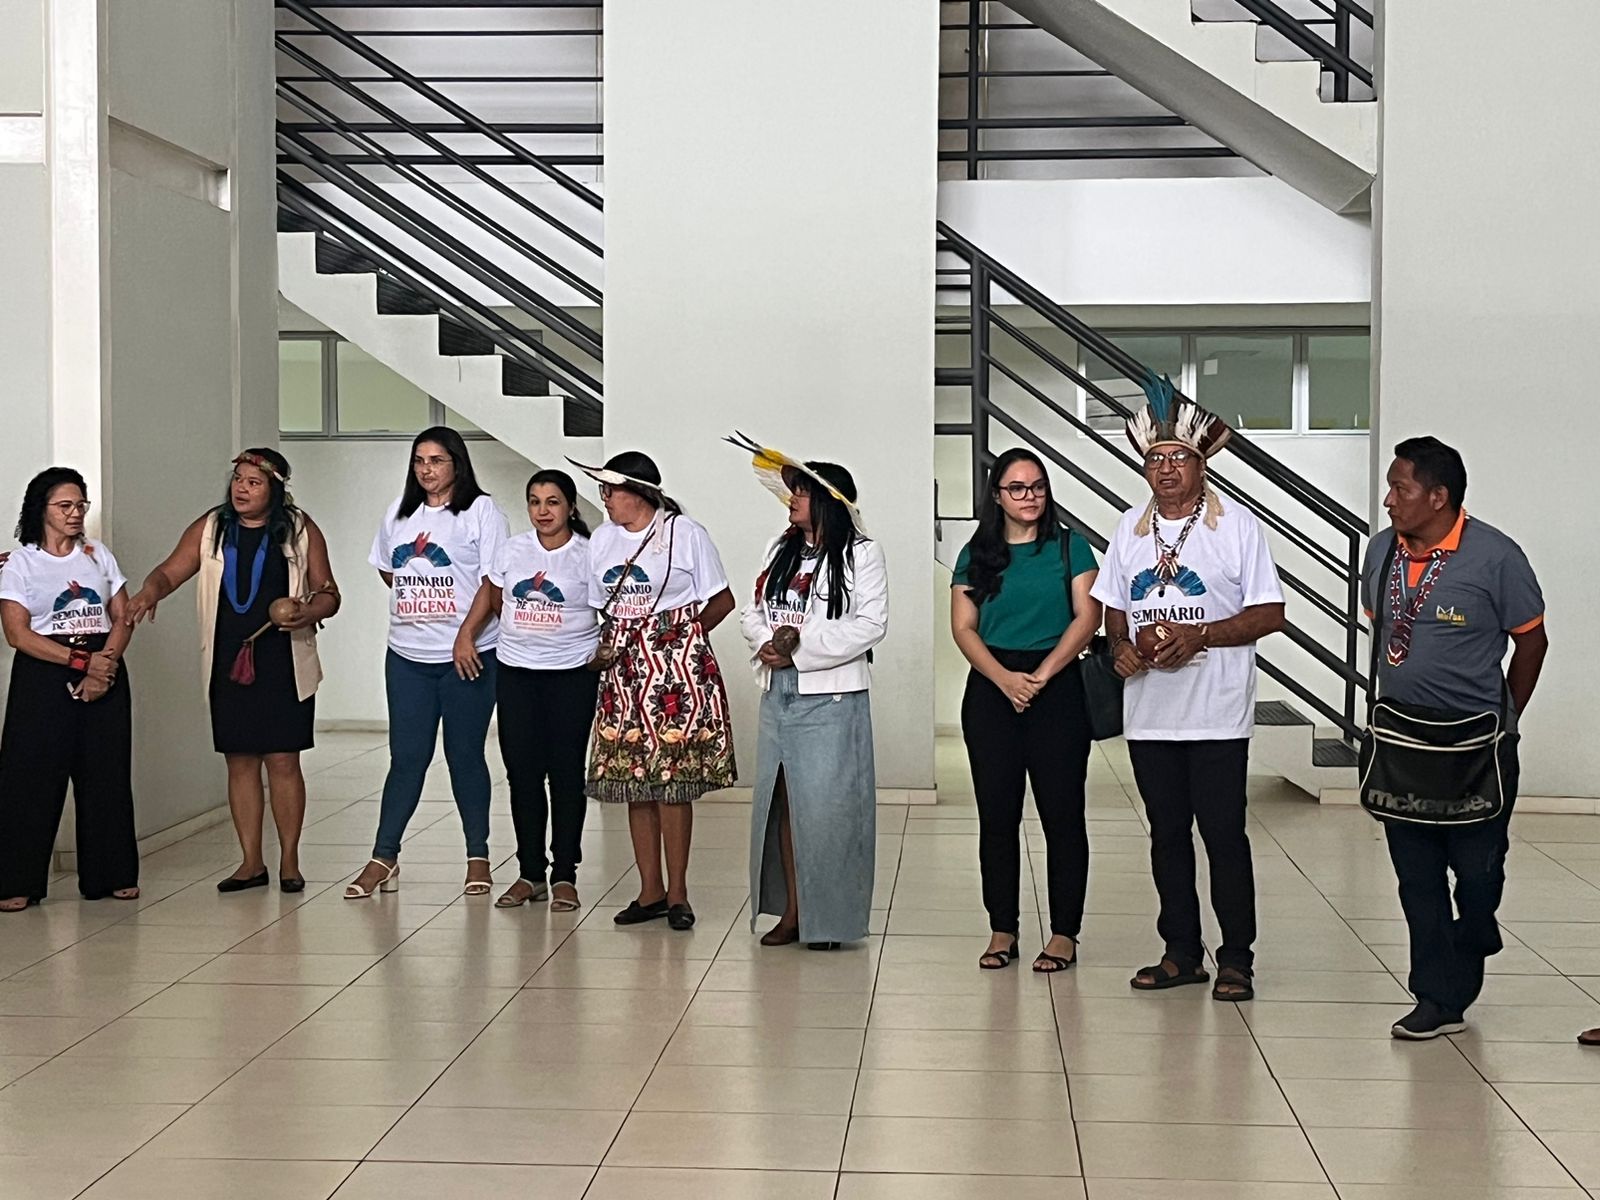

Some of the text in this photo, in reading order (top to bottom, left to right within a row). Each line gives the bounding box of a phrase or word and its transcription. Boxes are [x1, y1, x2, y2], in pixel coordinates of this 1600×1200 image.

[52, 605, 102, 621] SEMINÁRIO
[397, 598, 457, 613] NDÍGENA
[514, 610, 563, 624] INDÍGENA
[1132, 605, 1205, 624] SEMINÁRIO
